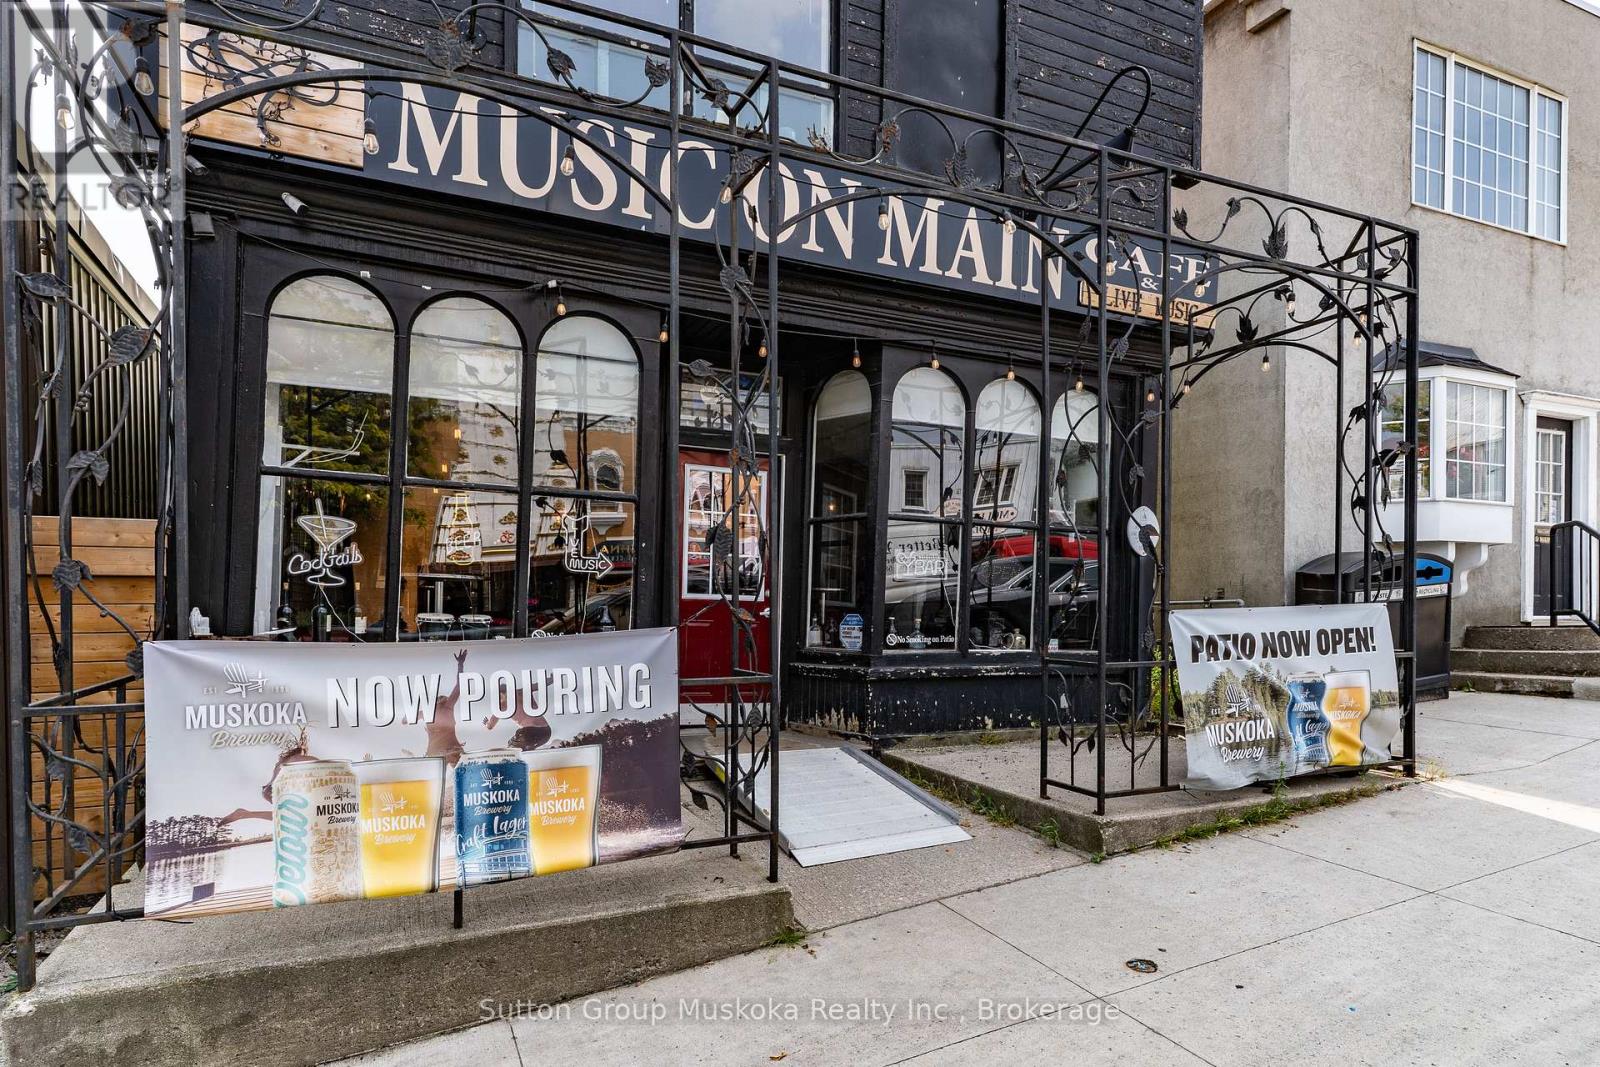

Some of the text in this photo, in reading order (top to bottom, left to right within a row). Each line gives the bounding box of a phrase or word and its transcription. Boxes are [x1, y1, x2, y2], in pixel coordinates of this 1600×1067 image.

[388, 82, 1070, 300] MUSIC ON MAIN
[1140, 277, 1160, 291] &
[569, 558, 607, 570] MUSIC
[897, 635, 906, 644] No
[906, 635, 932, 645] Smoking
[940, 635, 955, 643] Patio
[1190, 626, 1377, 664] PATIO NOW OPEN!
[327, 663, 653, 729] NOW POURING
[185, 701, 308, 730] MUSKOKA
[210, 730, 287, 749] Brewery
[1205, 718, 1276, 748] MUSKOKA
[1221, 745, 1265, 763] Brewery
[463, 788, 521, 808] MUSKOKA
[529, 797, 586, 818] MUSKOKA
[473, 804, 513, 816] Brewery
[361, 813, 426, 834] MUSKOKA
[493, 815, 528, 841] Lager
